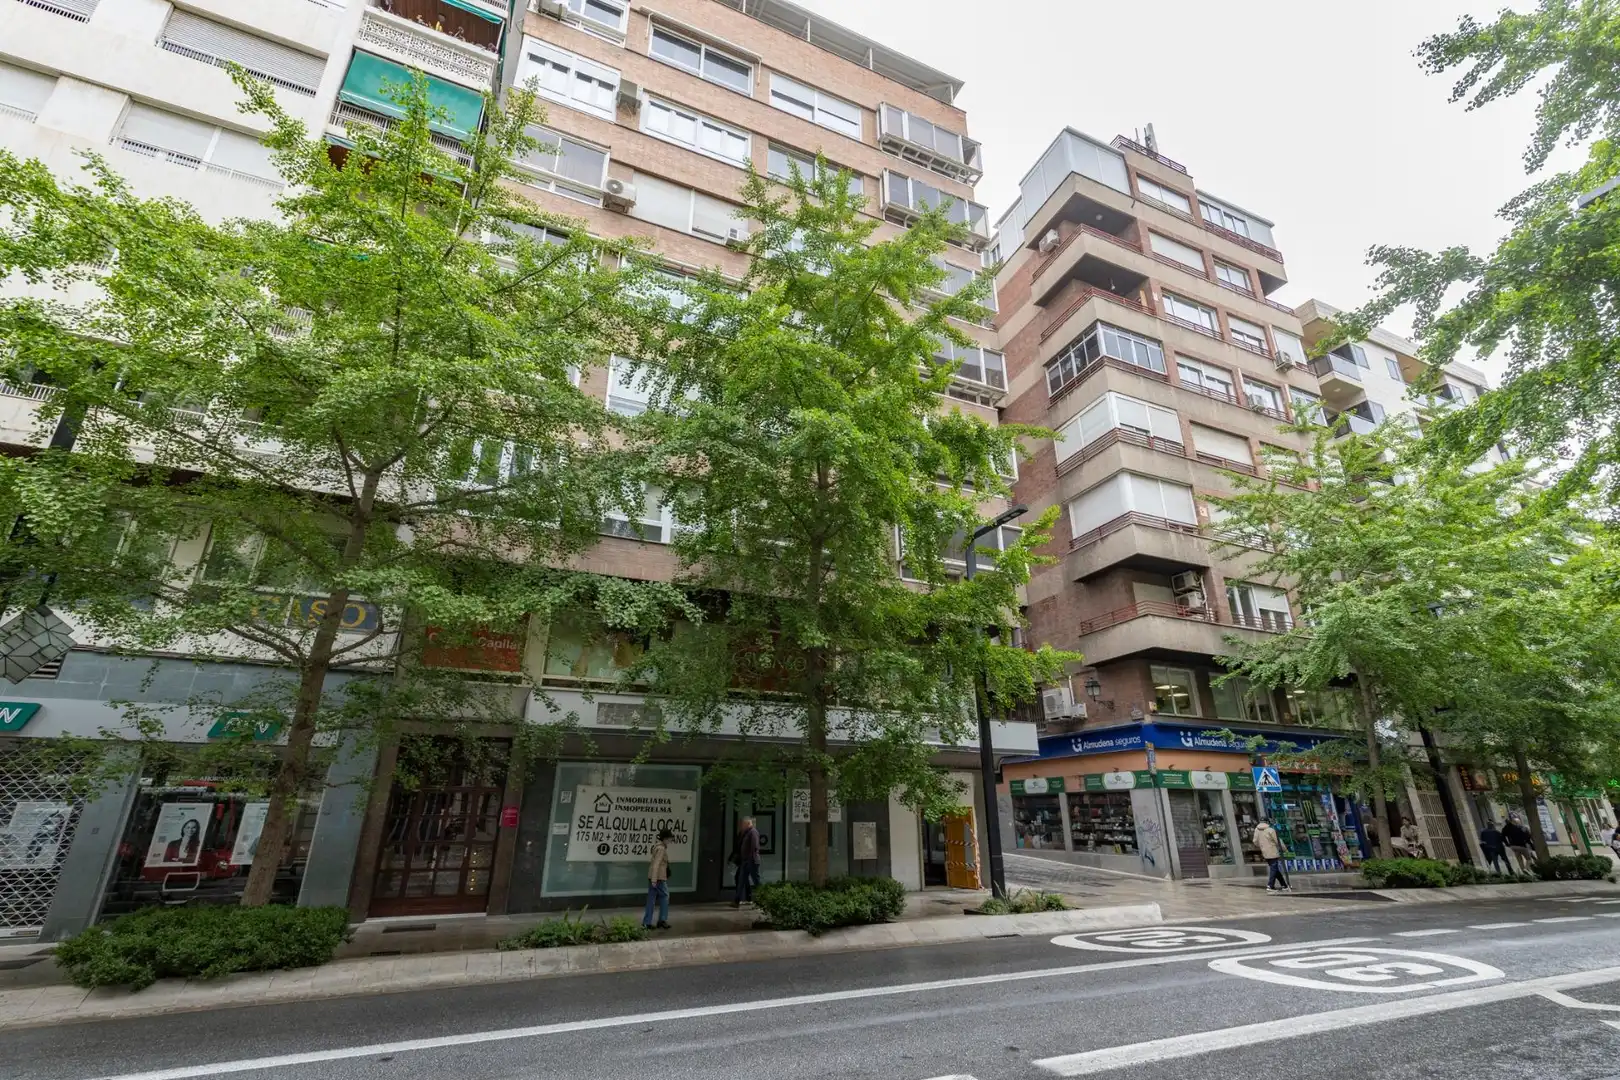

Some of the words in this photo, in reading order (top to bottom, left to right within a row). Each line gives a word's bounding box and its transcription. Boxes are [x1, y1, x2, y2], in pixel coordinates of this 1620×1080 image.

[1083, 740, 1114, 750] Almudena
[1115, 736, 1141, 748] seguros
[1194, 736, 1227, 748] Almudena
[616, 796, 671, 805] INMOBILIARIA
[615, 804, 672, 813] INMOPERELMA
[578, 815, 594, 830] SE
[596, 817, 647, 832] ALQUILA
[650, 819, 687, 832] LOCAL
[576, 832, 589, 842] 175
[592, 832, 603, 842] M2
[613, 833, 628, 843] 200
[629, 834, 640, 843] M2
[642, 834, 653, 844] DE
[656, 834, 688, 845] SANO
[612, 845, 629, 855] 633
[631, 846, 647, 856] 424
[1268, 953, 1444, 982] 30
